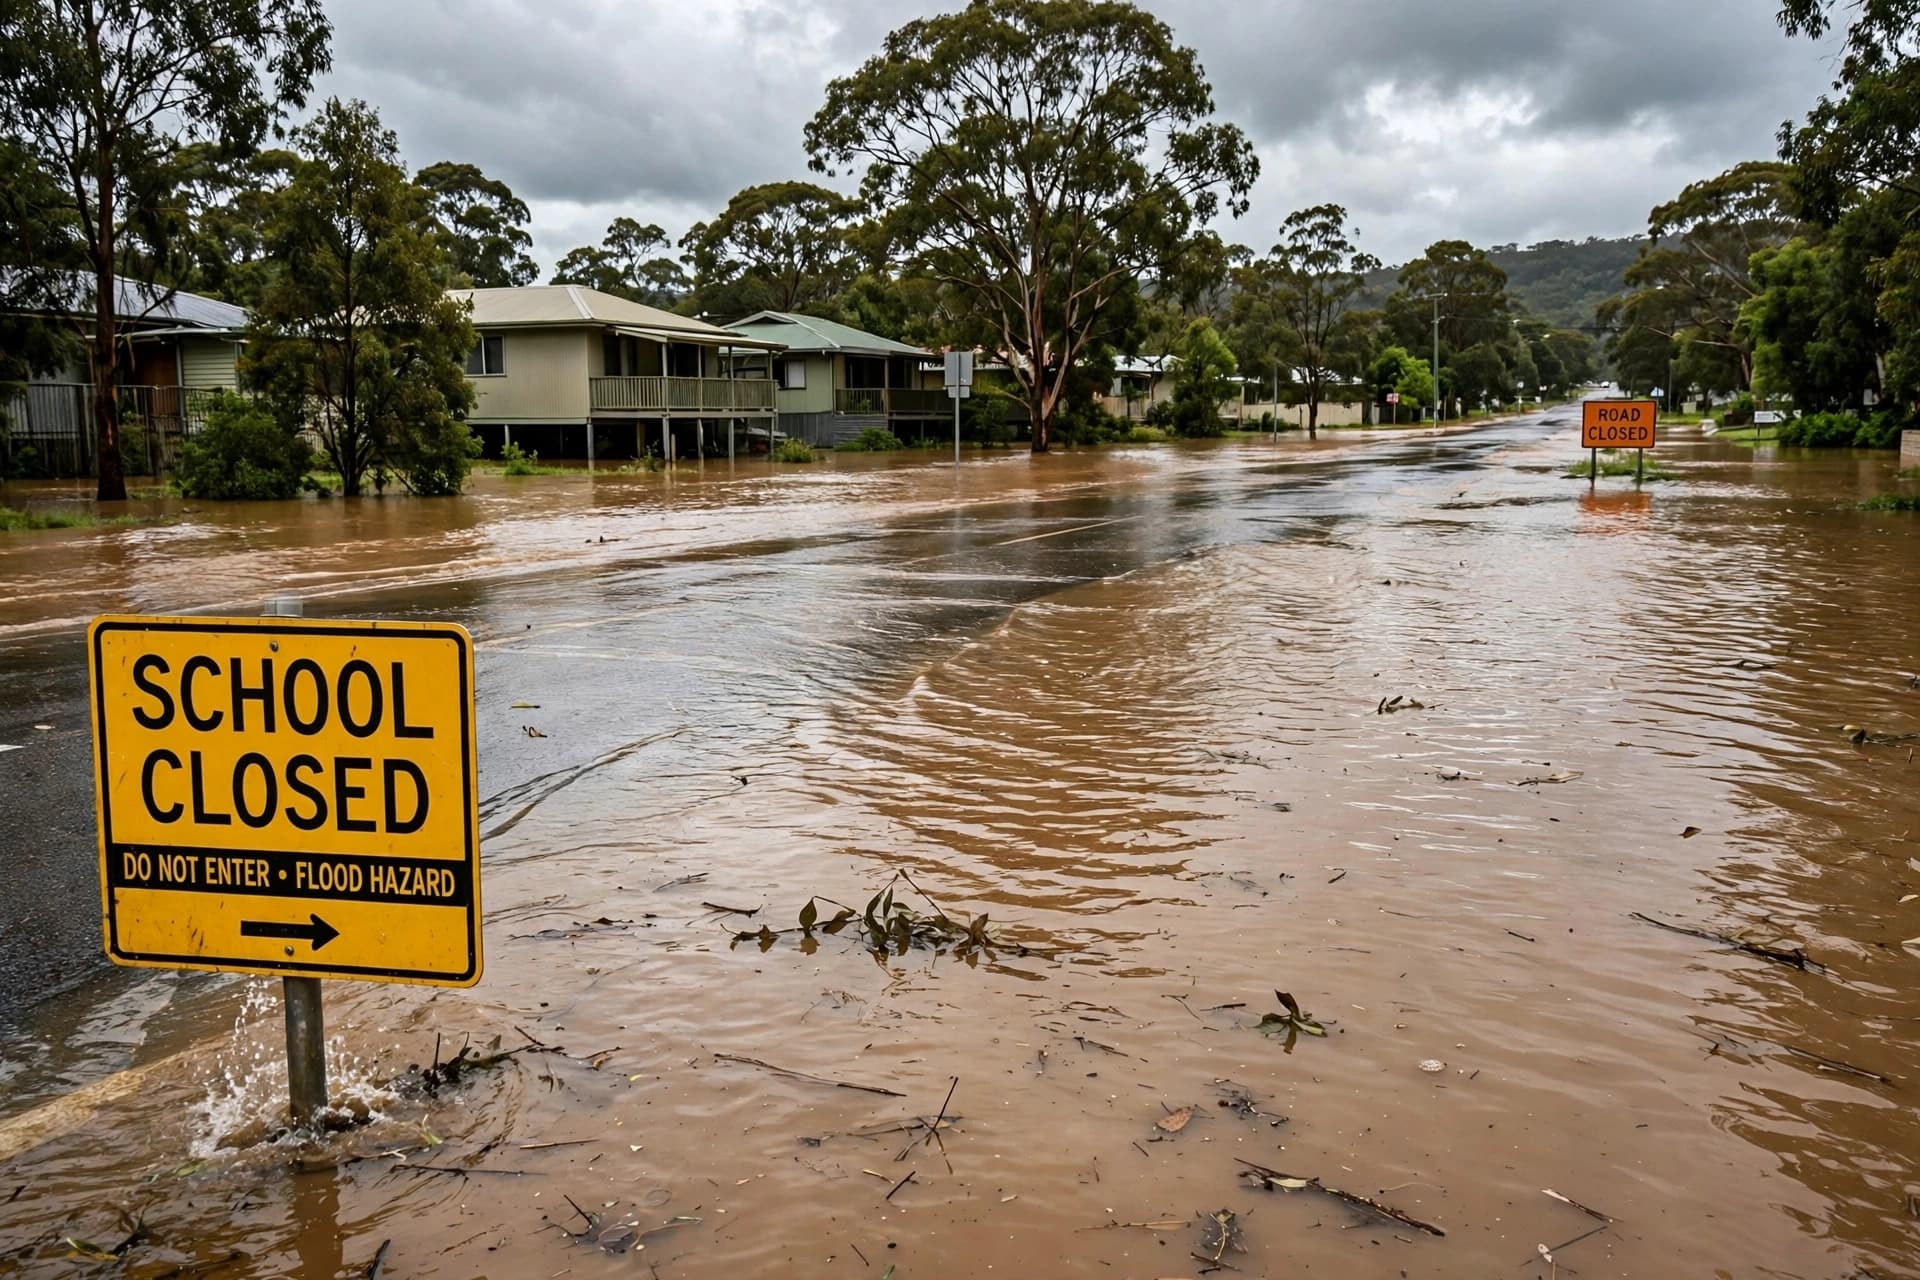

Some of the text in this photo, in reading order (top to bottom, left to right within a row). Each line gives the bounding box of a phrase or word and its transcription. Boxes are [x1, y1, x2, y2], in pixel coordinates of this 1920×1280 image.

[1588, 426, 1648, 440] CLOSED
[1599, 408, 1641, 422] ROAD
[132, 654, 434, 739] SCHOOL
[141, 749, 429, 834] CLOSED
[123, 853, 455, 898] DO NOT ENTER FLOOD HAZARD
